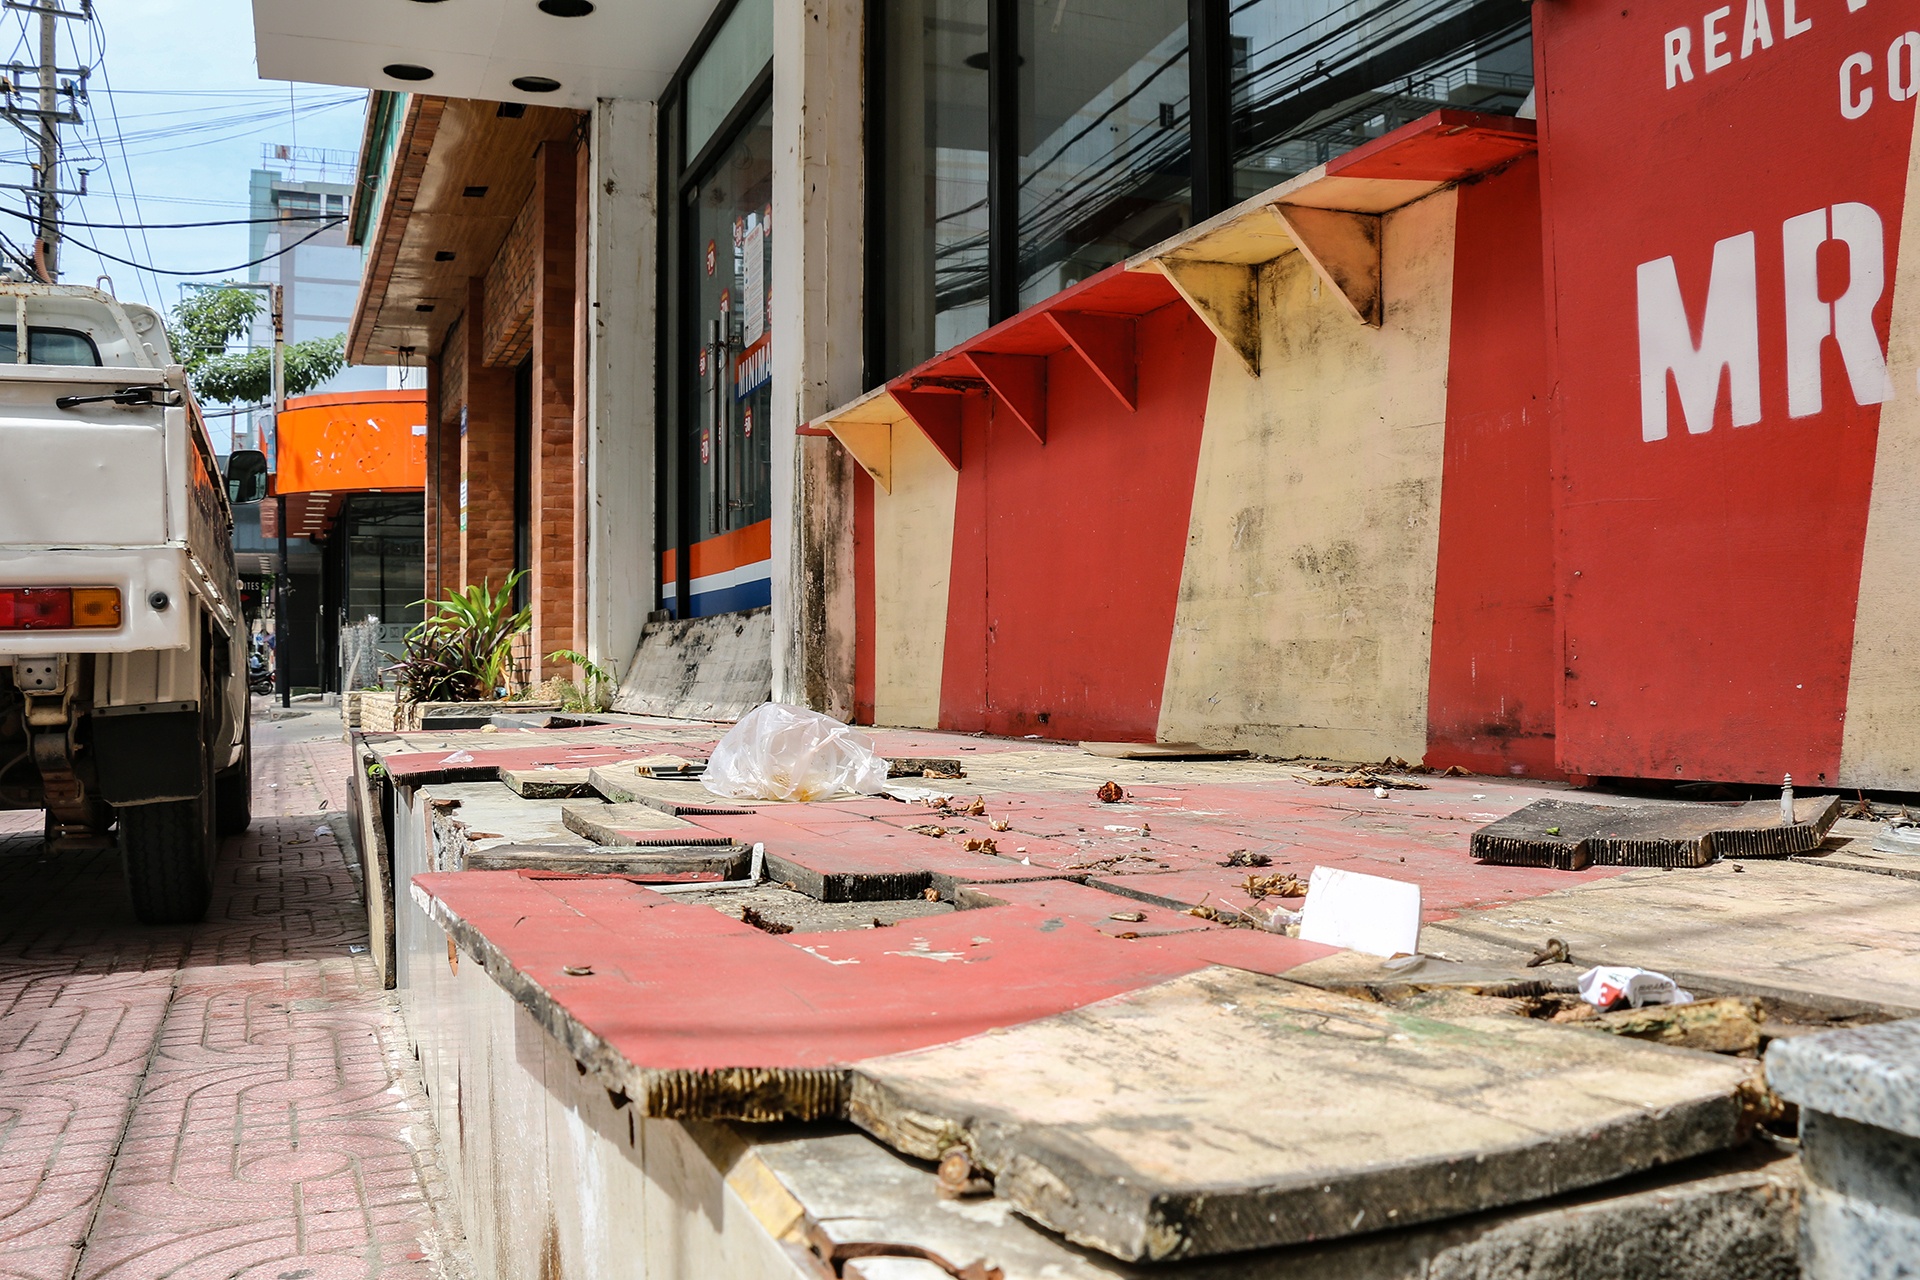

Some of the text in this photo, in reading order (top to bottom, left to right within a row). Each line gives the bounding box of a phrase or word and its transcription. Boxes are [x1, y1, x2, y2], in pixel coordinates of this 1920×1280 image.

[1664, 0, 1812, 90] REAL
[1839, 31, 1920, 120] CO
[1636, 201, 1896, 443] MR
